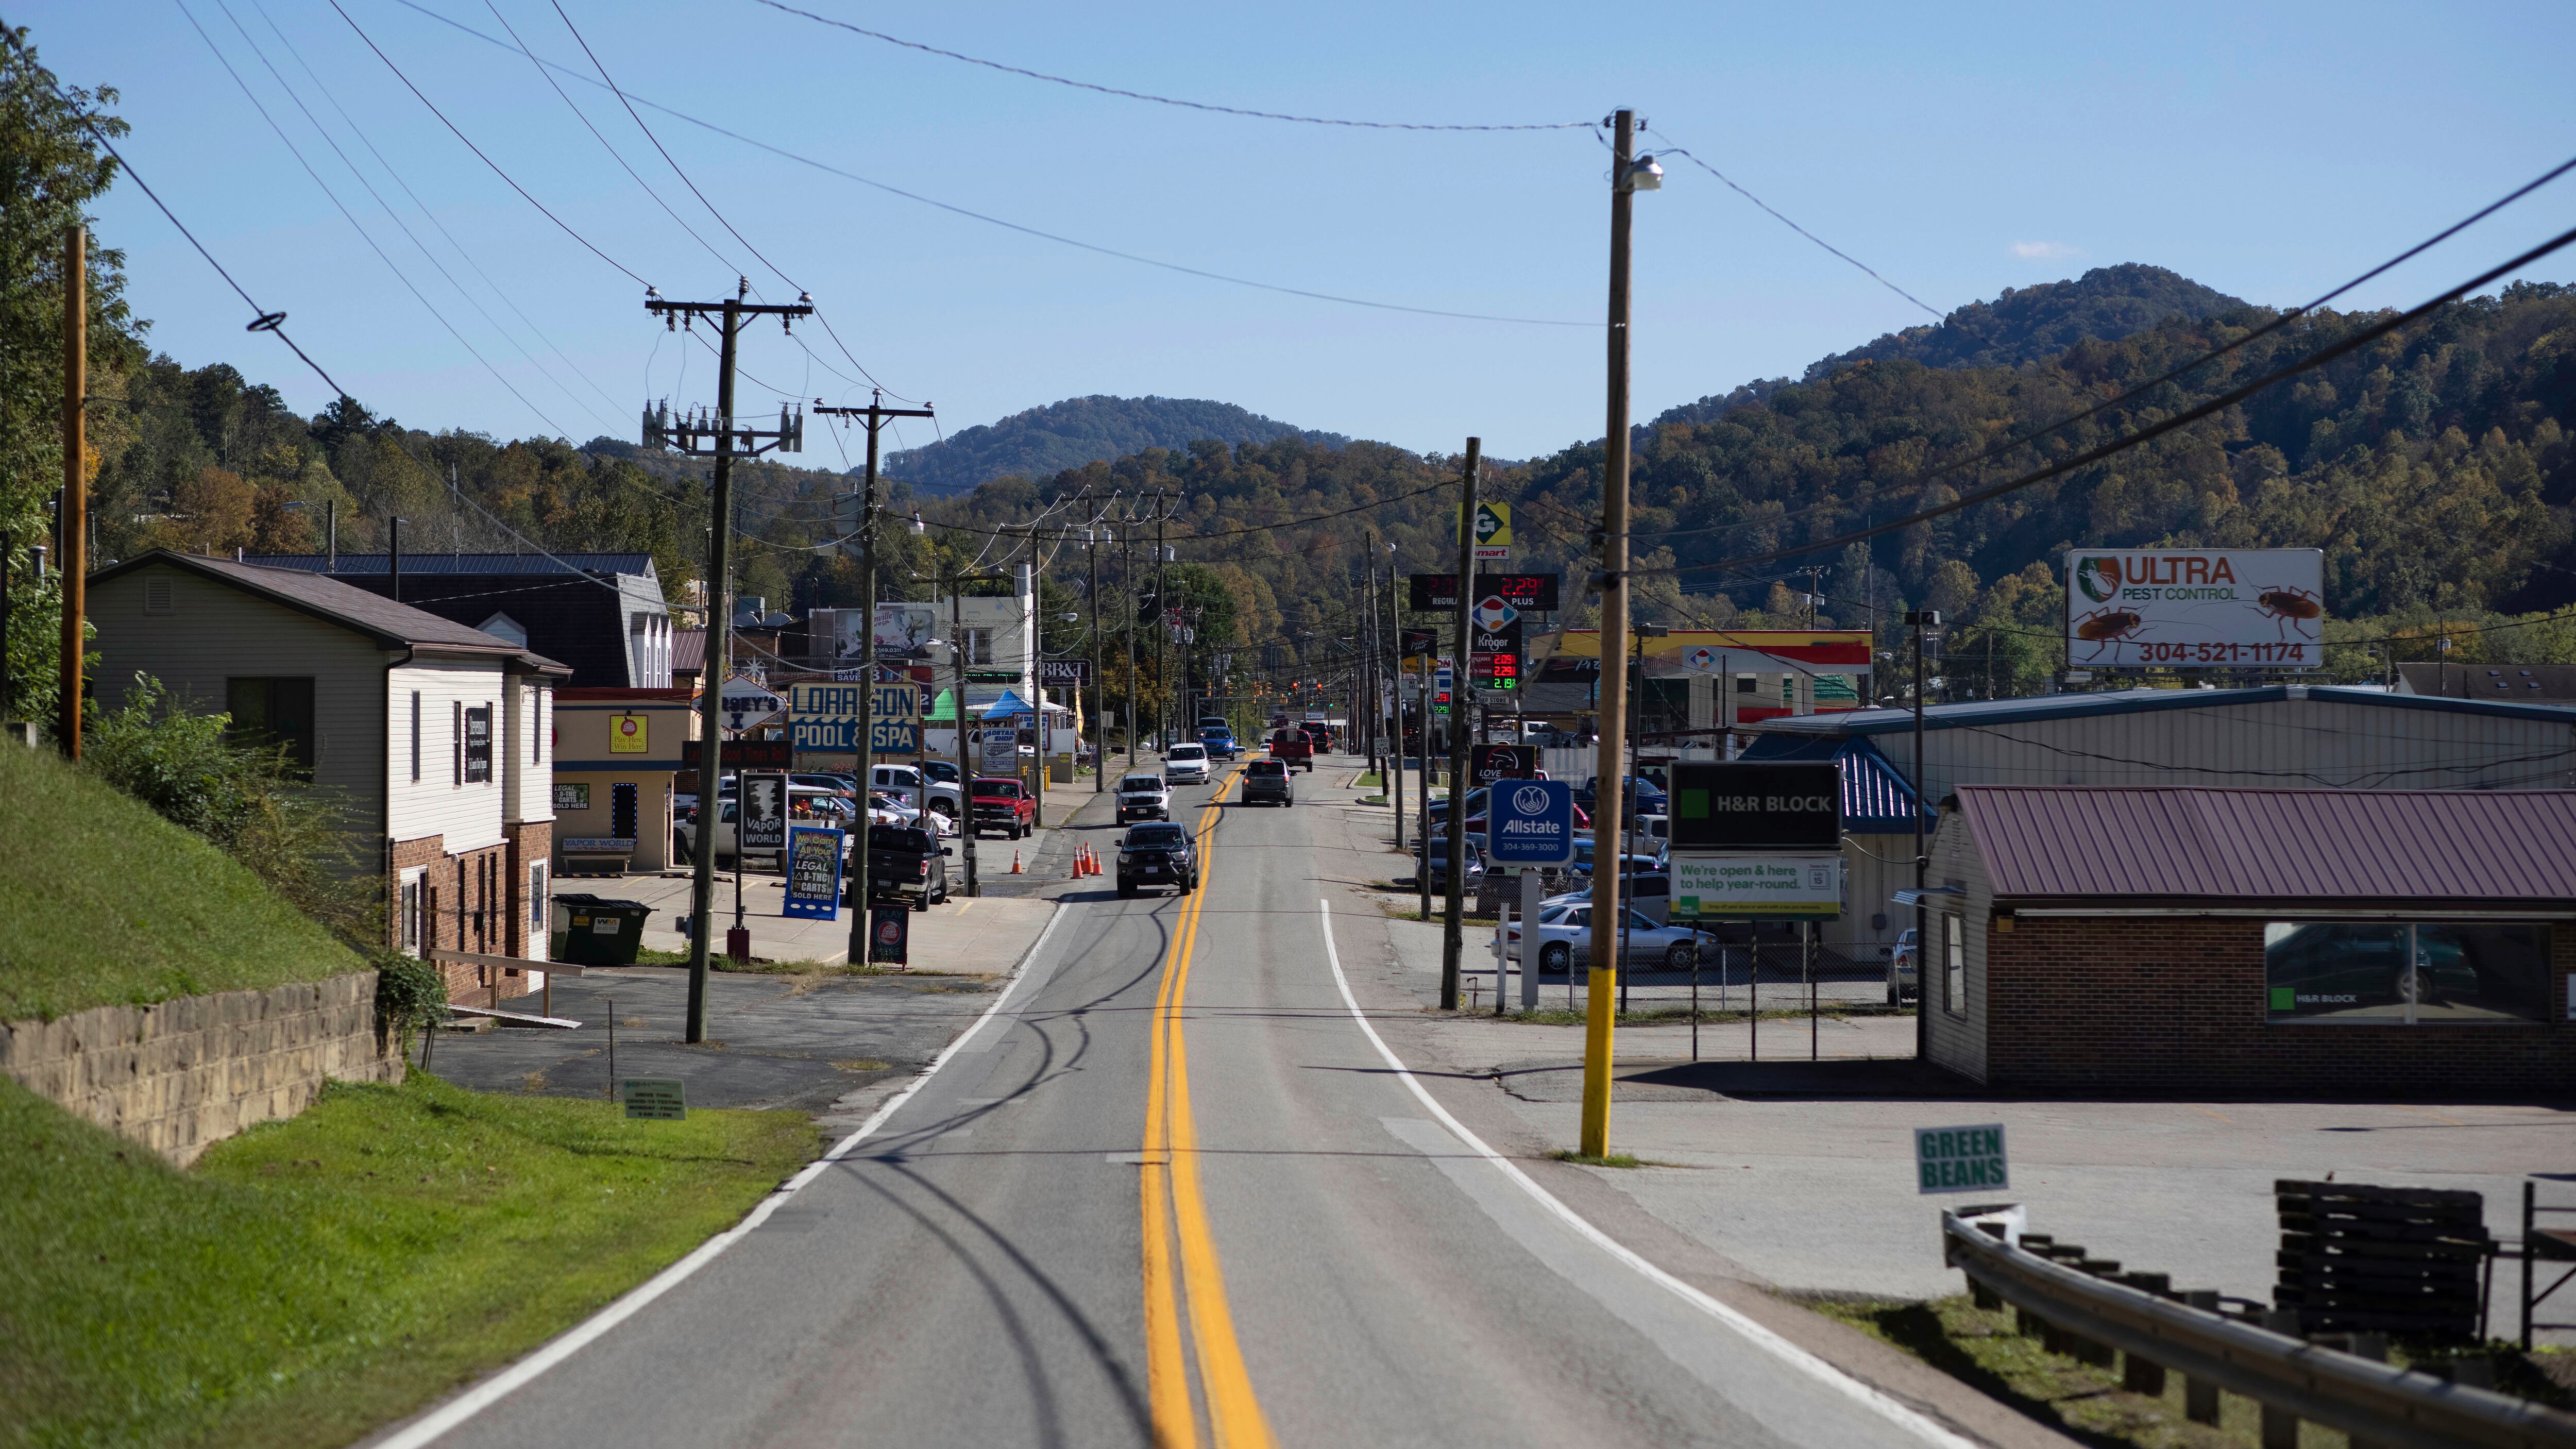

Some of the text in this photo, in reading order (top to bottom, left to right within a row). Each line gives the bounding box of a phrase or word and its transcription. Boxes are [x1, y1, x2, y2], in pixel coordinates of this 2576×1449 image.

[2125, 557, 2236, 584] ULTRA
[2122, 587, 2239, 600] PEST CONTROL
[1411, 638, 1430, 650] Pizza
[1478, 633, 1509, 651] Kroger
[2139, 642, 2304, 662] 304-521-1174
[1042, 662, 1086, 678] BB&T
[792, 687, 914, 716] LORRSON
[794, 725, 849, 747] POOL
[874, 726, 914, 747] SPA
[1717, 796, 1832, 812] H&R BLOCK
[747, 817, 782, 833] VAPOR
[1502, 820, 1560, 834] Allstate
[745, 834, 782, 844] WORLD
[795, 834, 838, 847] We Carry
[814, 847, 833, 855] Your
[795, 861, 828, 871] LEGAL
[1680, 865, 1797, 879] We're open & here
[803, 872, 828, 882] 8-THC
[801, 883, 827, 892] CARTS
[1680, 879, 1801, 891] to help year-round.
[879, 910, 902, 918] PLAY
[2296, 995, 2357, 1003] H&R BLOCK
[1921, 1128, 2001, 1159] GREEN
[1921, 1157, 2004, 1188] BEANS
